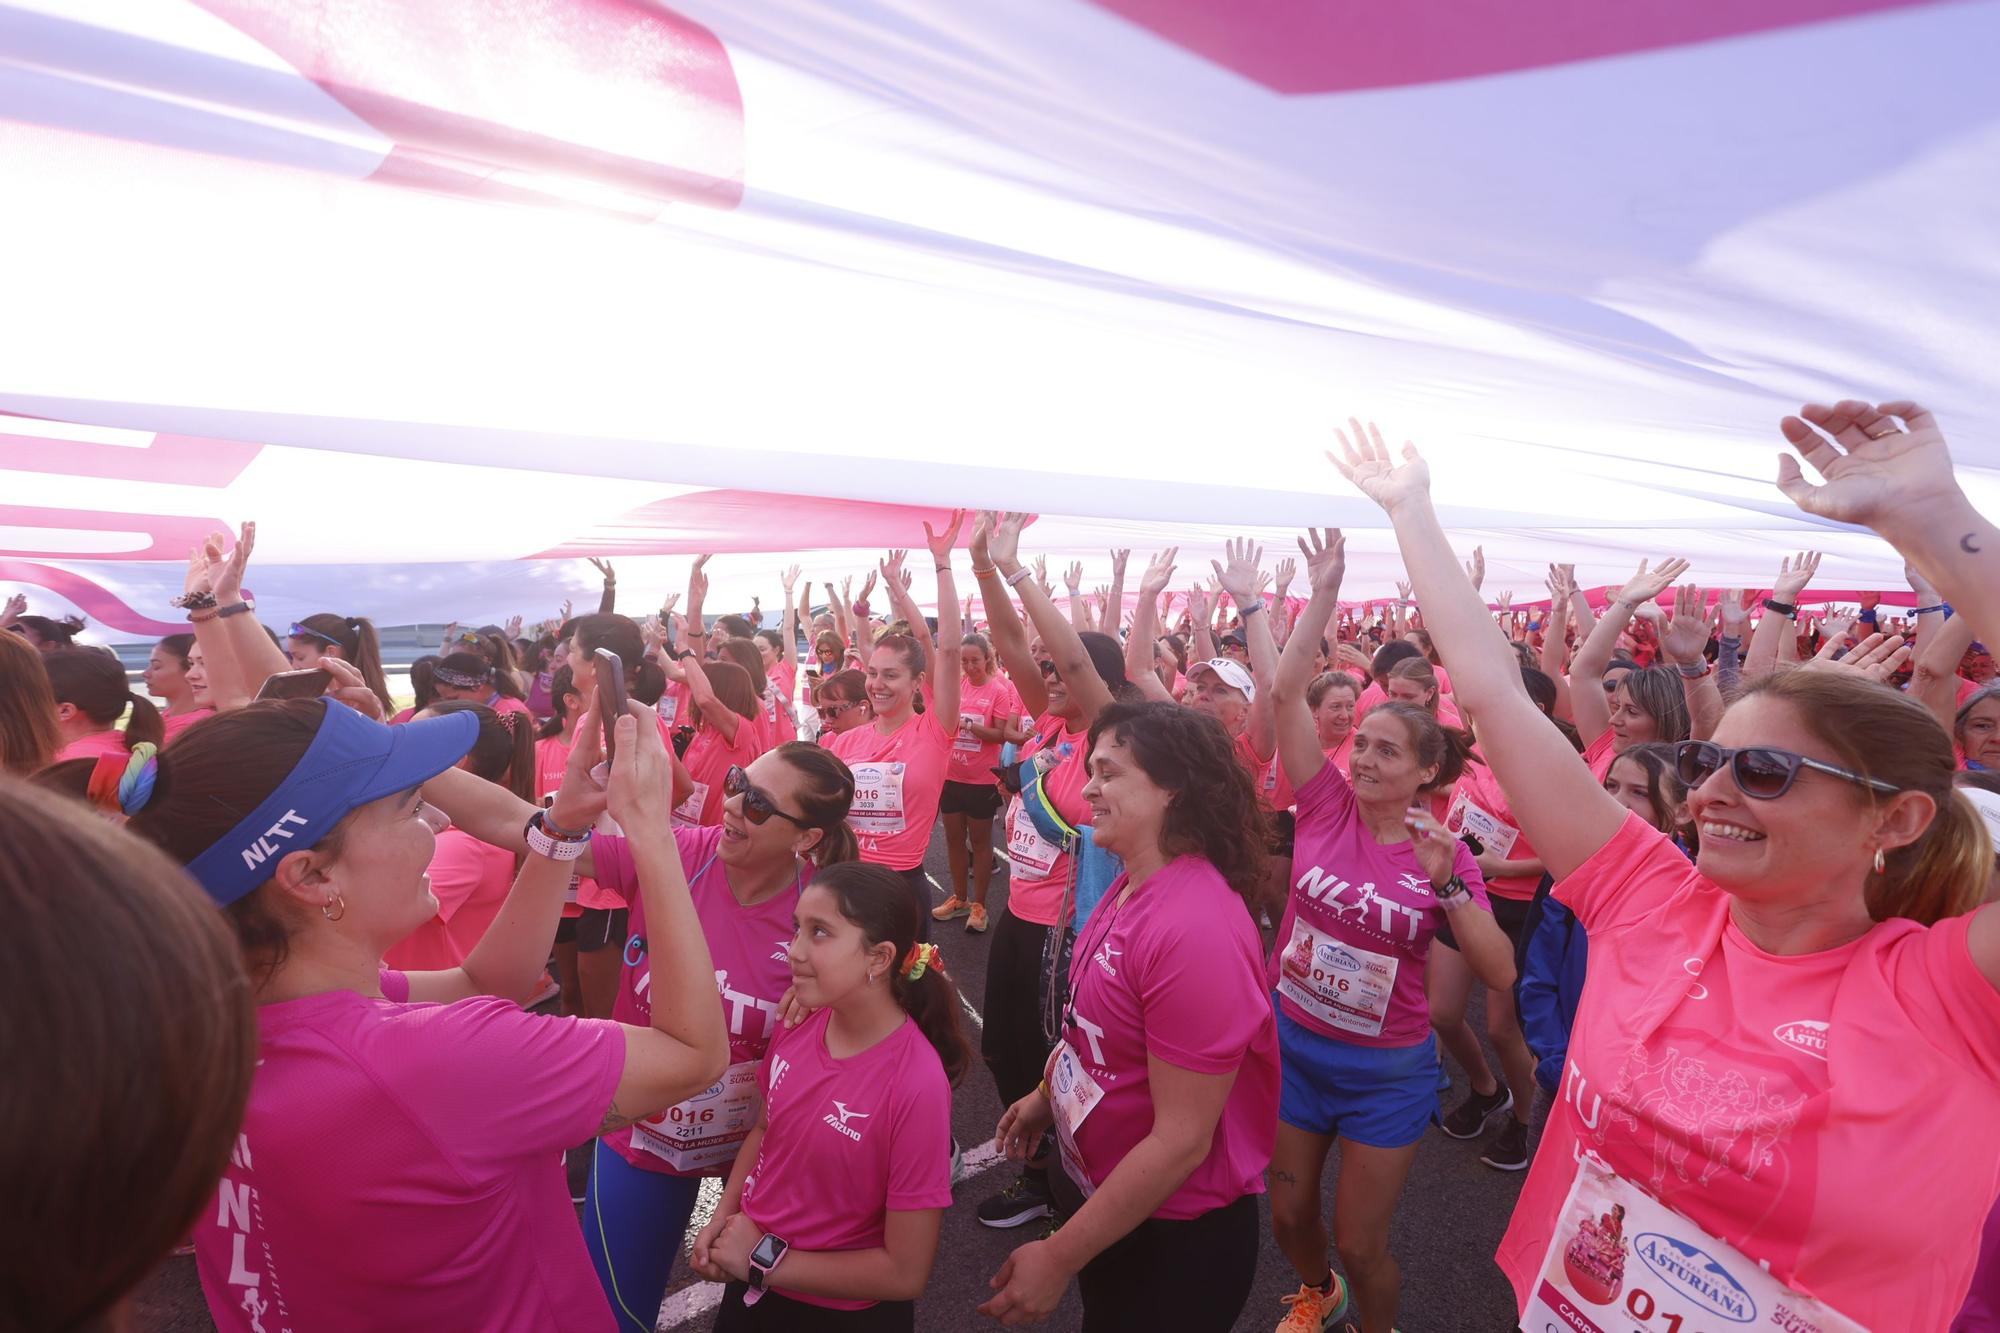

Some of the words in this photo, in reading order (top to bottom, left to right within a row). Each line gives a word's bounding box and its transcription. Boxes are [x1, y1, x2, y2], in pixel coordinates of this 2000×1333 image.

[855, 789, 879, 800] 016
[860, 801, 875, 809] 3039
[241, 808, 309, 871] NLTT
[1014, 830, 1036, 846] 016
[1296, 865, 1424, 941] NLTT
[1313, 968, 1350, 992] 016
[1317, 985, 1341, 1000] 1982
[1091, 1068, 1117, 1081] TEAM
[1566, 1059, 1602, 1130] TU
[670, 1107, 715, 1124] 016
[823, 1113, 862, 1142] MIZUNO
[675, 1126, 704, 1138] 2211
[1640, 1240, 1745, 1319] ASTURIANA
[1559, 1303, 1599, 1333] CARR
[1626, 1288, 1704, 1333] 01
